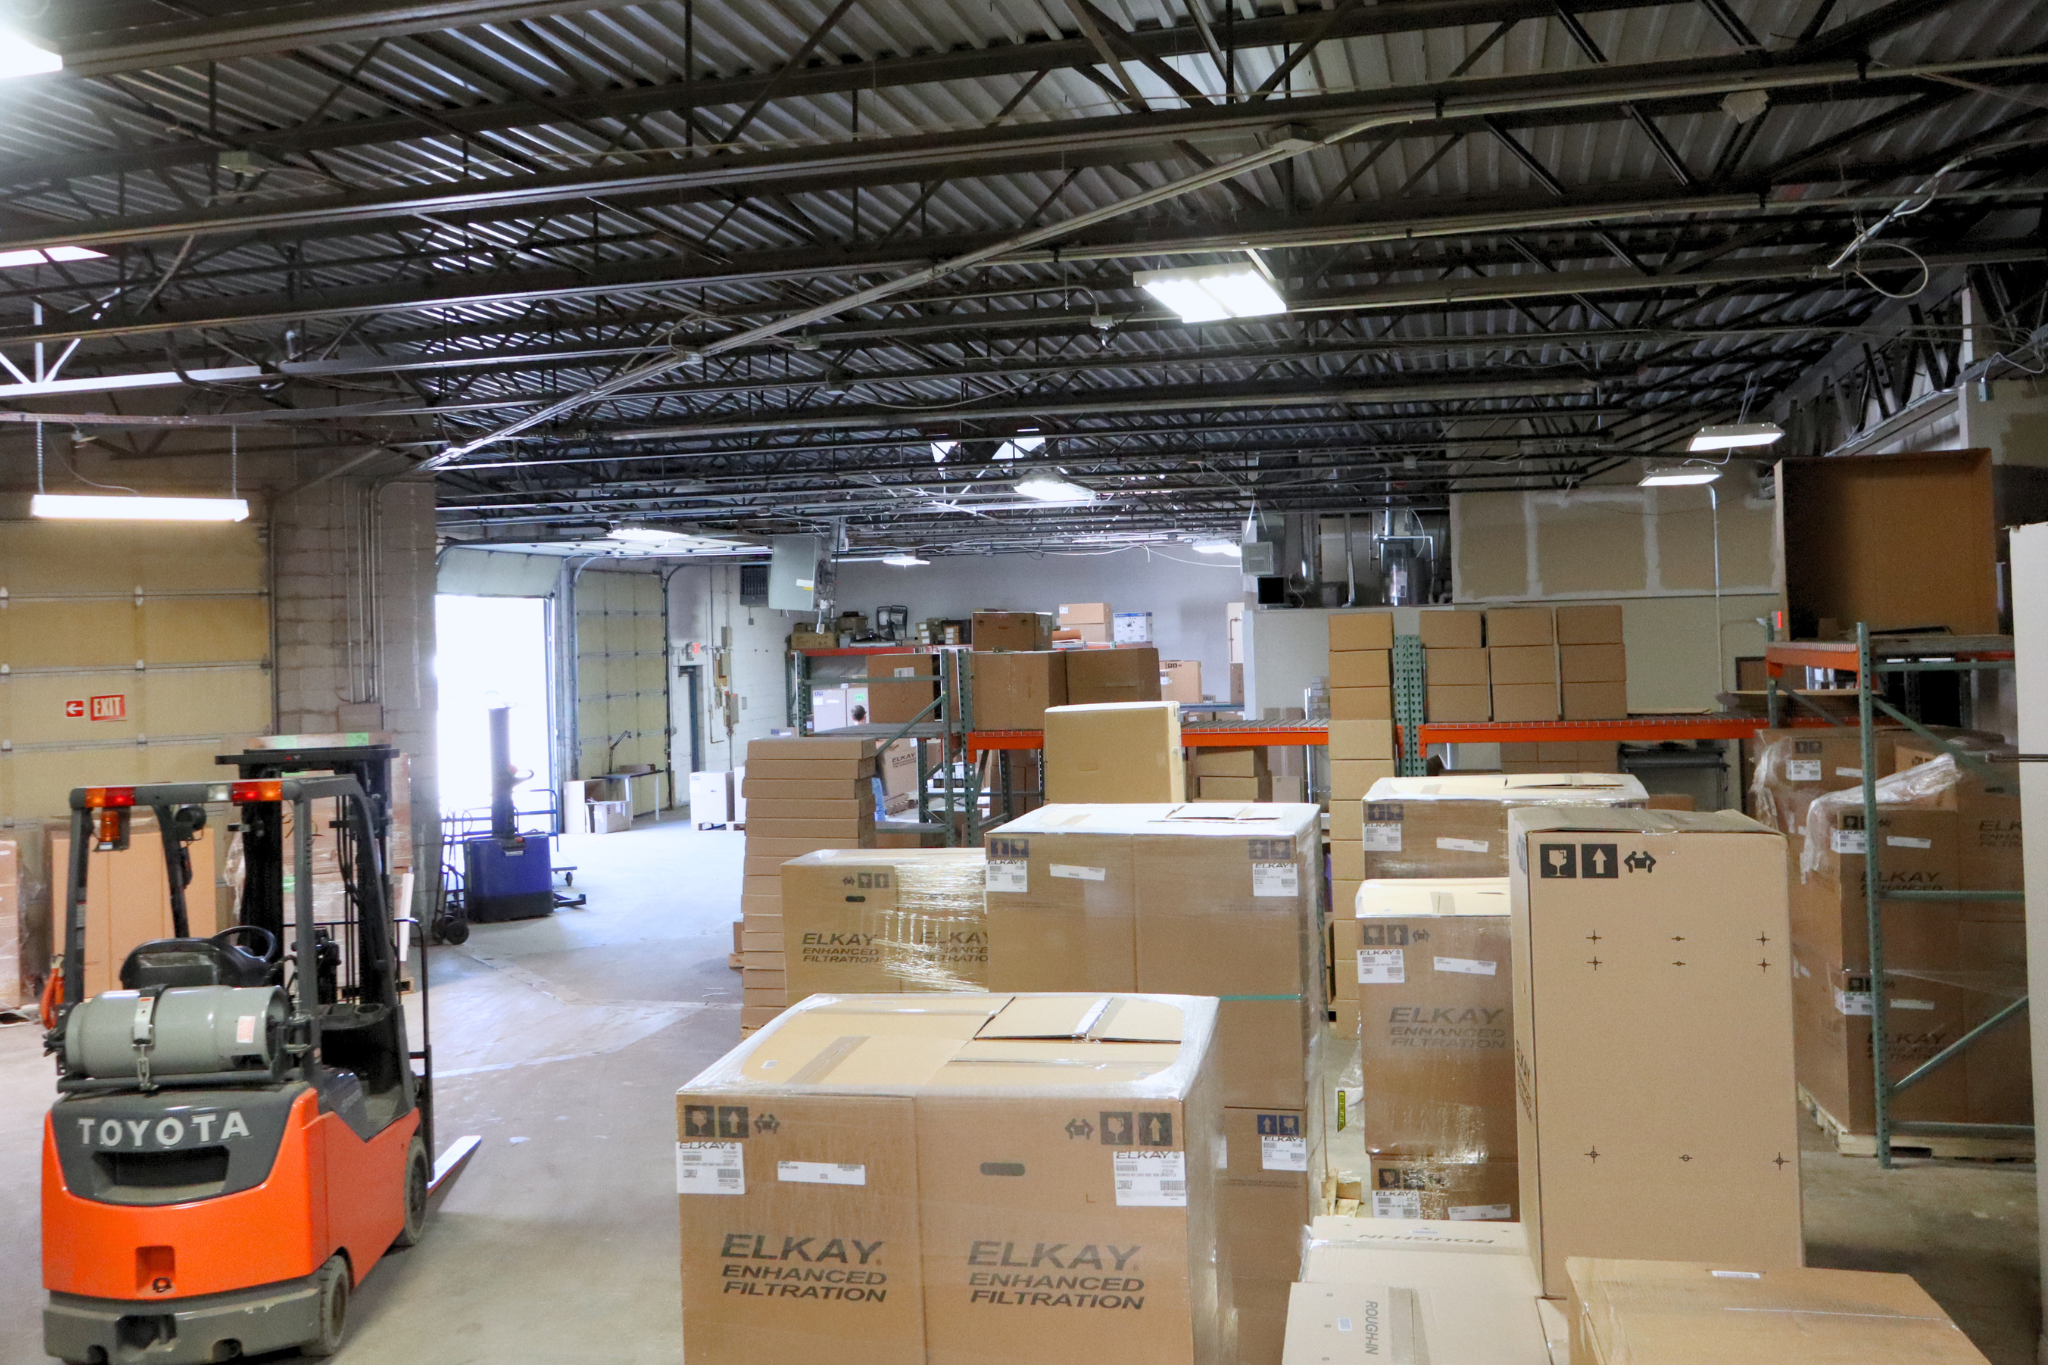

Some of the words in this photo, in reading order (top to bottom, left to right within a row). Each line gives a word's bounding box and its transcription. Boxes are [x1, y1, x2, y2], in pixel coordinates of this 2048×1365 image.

[93, 697, 121, 717] EXIT
[892, 752, 916, 762] ELKAY
[1978, 820, 2022, 832] ELK
[802, 932, 878, 946] ELKAY
[802, 947, 879, 956] ENHANCED
[803, 955, 880, 964] FILTRATION
[1389, 1007, 1504, 1025] ELKAY
[1390, 1027, 1506, 1037] ENHANCED
[1391, 1037, 1506, 1049] FILTRATION
[77, 1110, 251, 1148] TOYOTA
[679, 1141, 730, 1149] ELKAY
[1116, 1151, 1171, 1159] ELKAY
[721, 1233, 885, 1265] ELKAY
[967, 1240, 1142, 1271] ELKAY
[722, 1264, 888, 1285] ENHANCED
[969, 1272, 1145, 1292] ENHANCED
[723, 1281, 888, 1303] FILTRATION
[970, 1289, 1145, 1310] FILTRATION
[1365, 1300, 1379, 1356] ROUGH-IN
